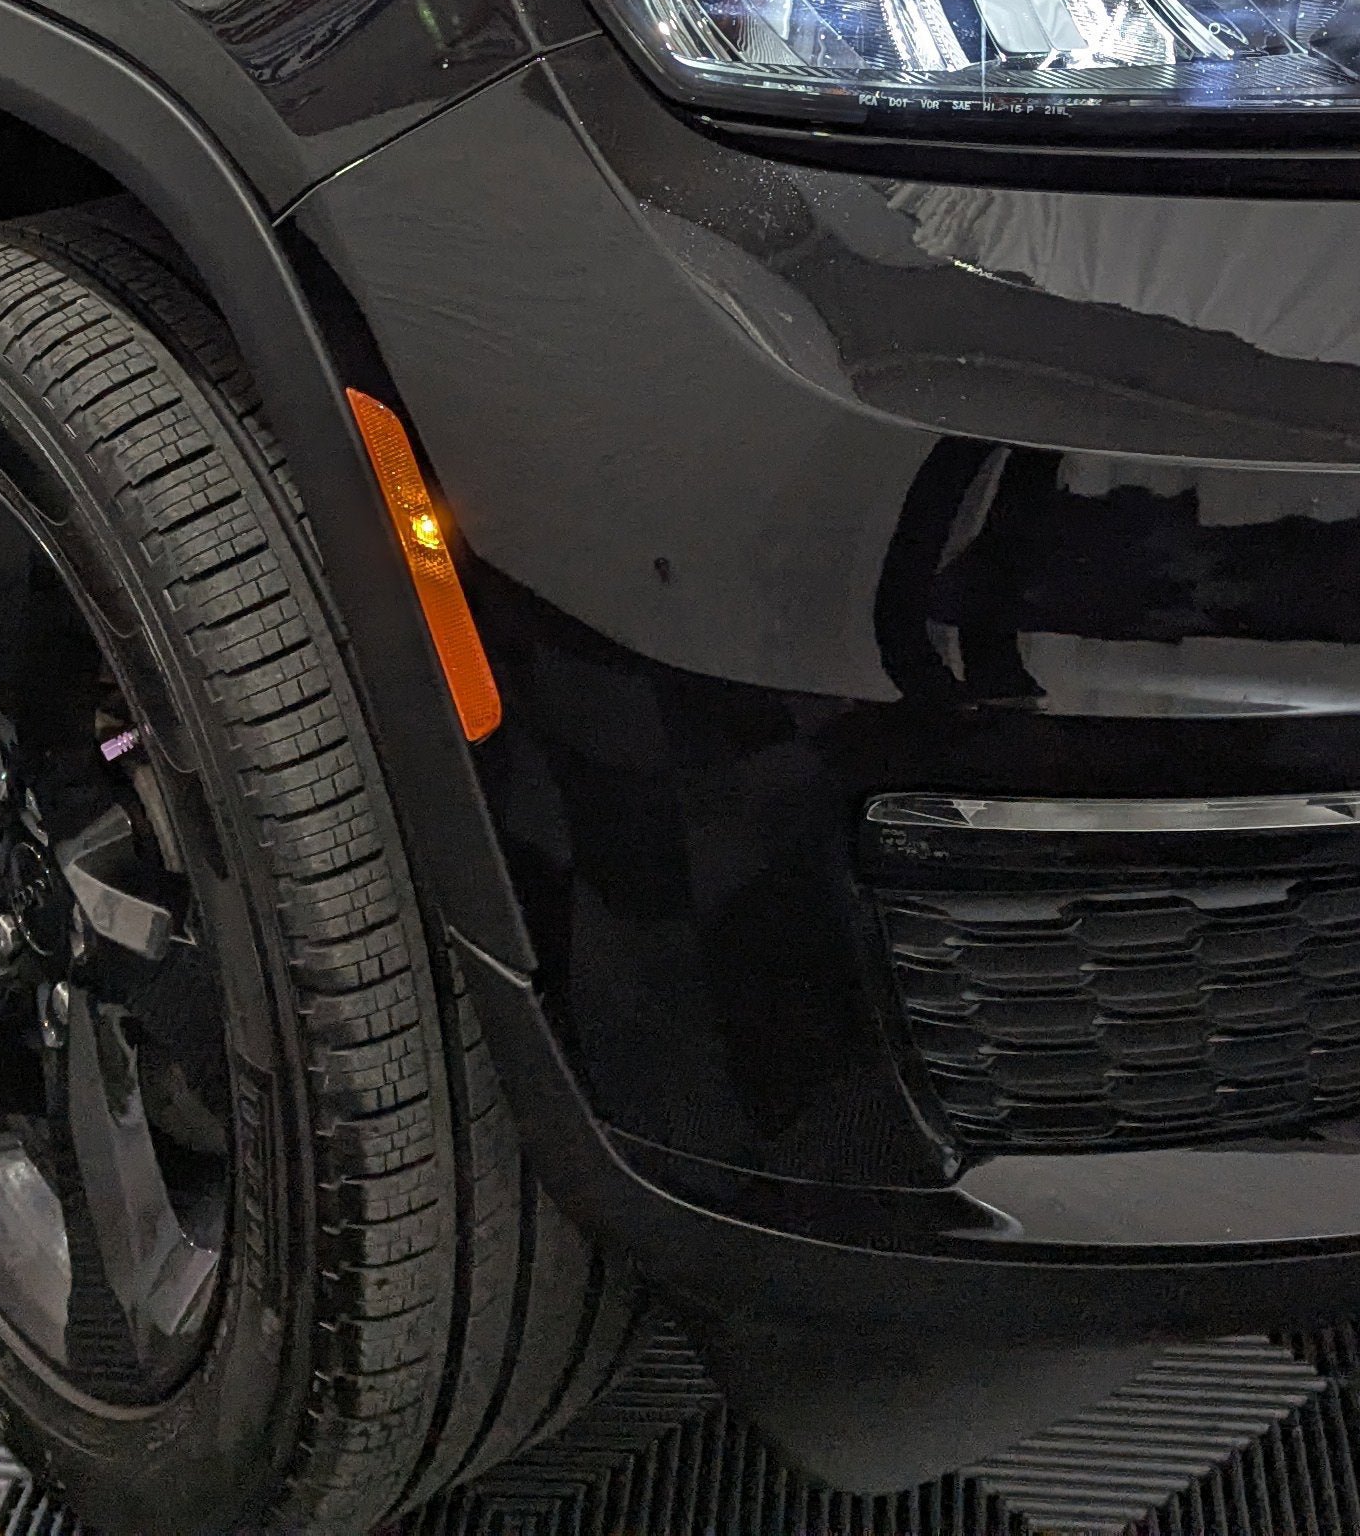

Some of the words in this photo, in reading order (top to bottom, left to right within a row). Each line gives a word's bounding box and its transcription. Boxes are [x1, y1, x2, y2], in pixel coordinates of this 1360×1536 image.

[888, 97, 908, 108] DOT
[921, 99, 940, 110] VOR
[952, 101, 971, 111] SAE
